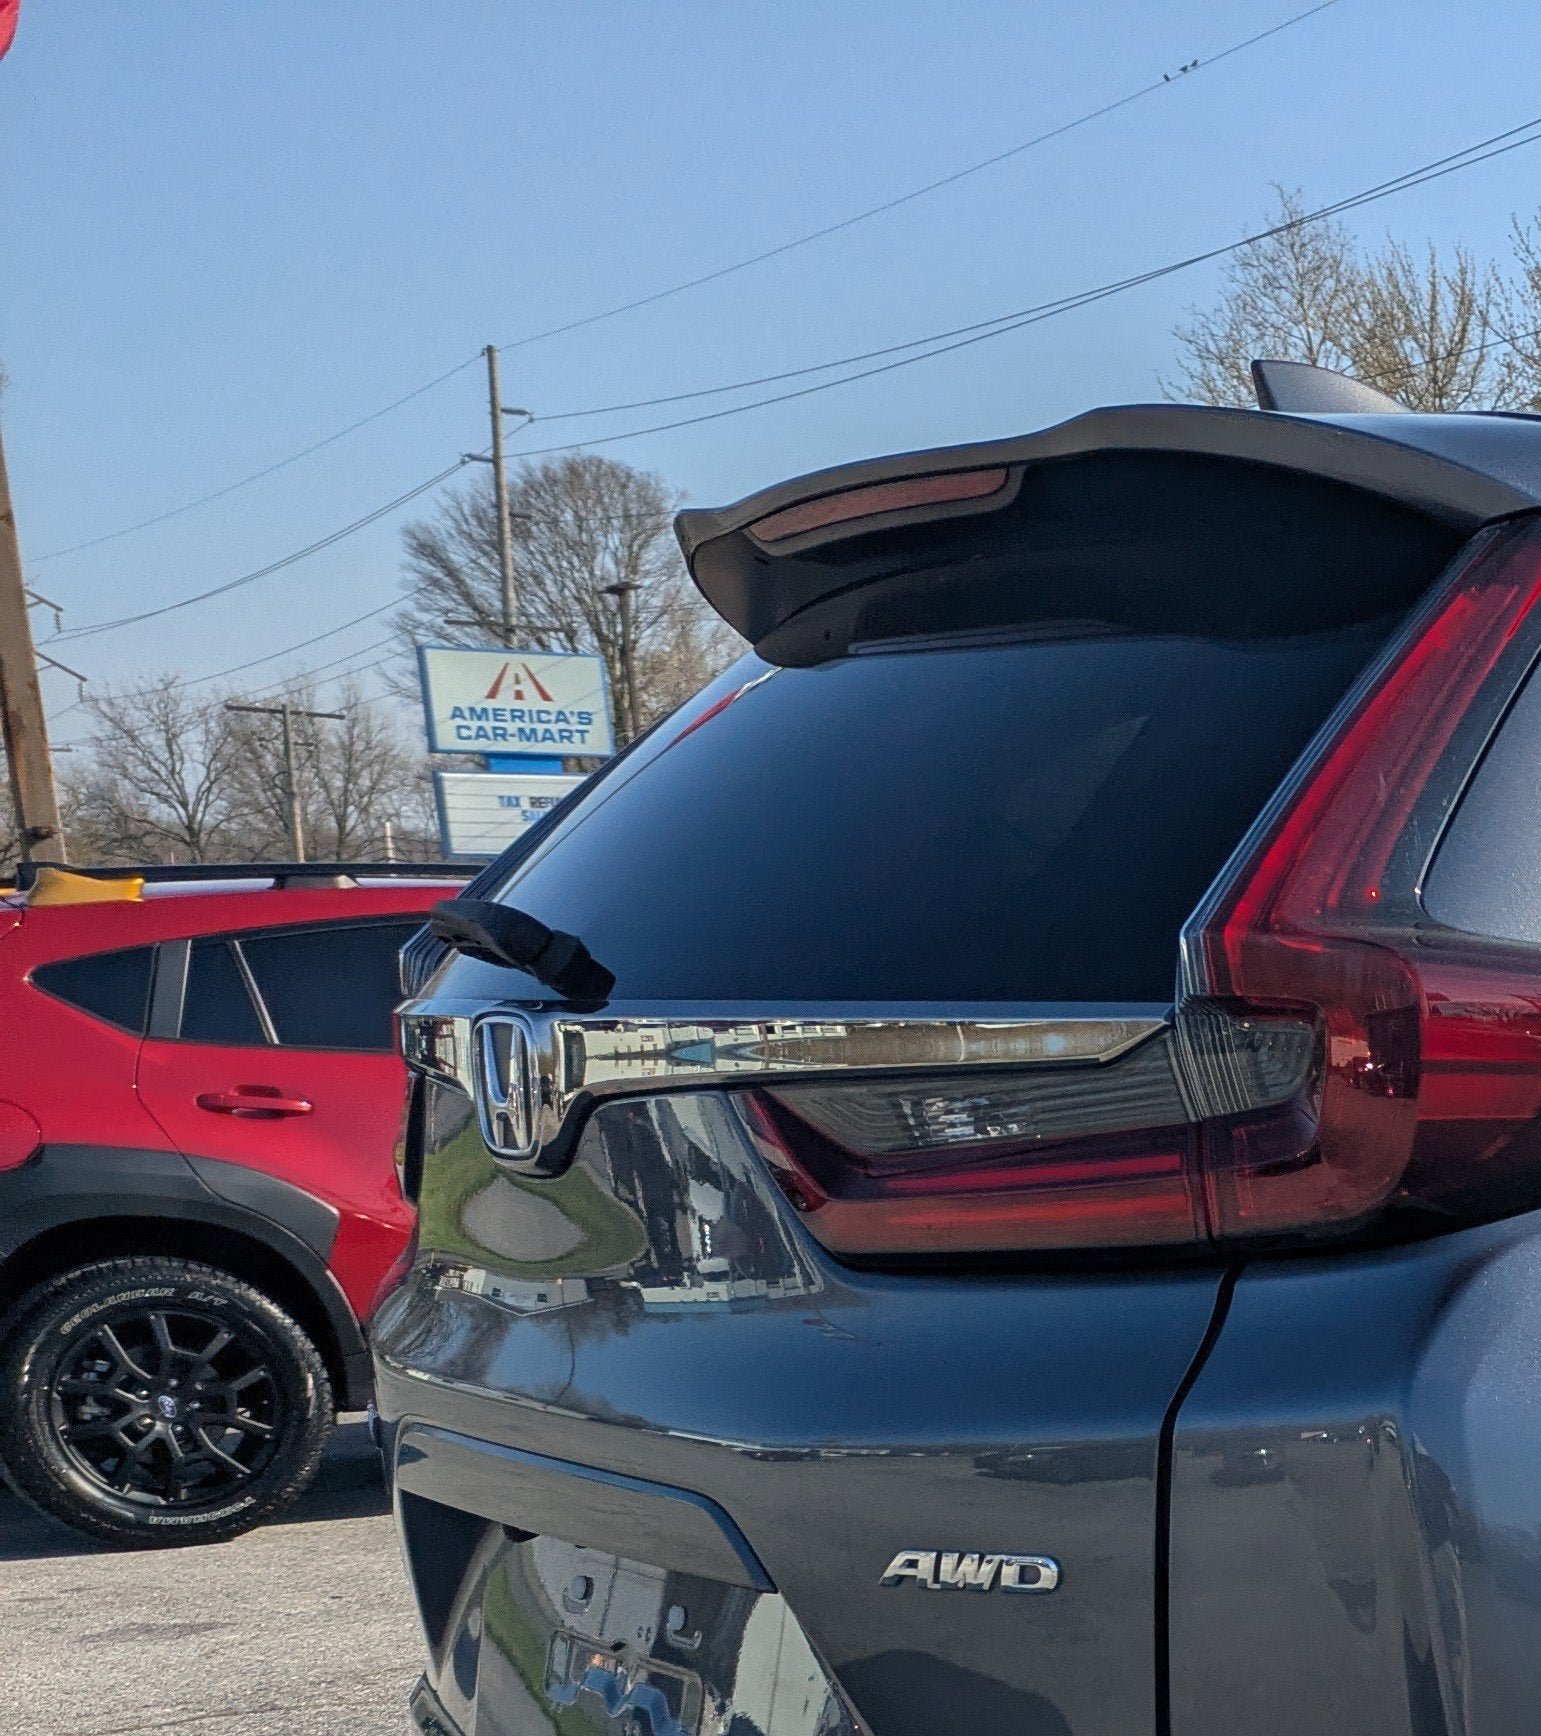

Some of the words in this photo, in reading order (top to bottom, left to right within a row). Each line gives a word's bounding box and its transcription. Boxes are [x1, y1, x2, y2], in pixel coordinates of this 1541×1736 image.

[449, 705, 594, 727] AMERICA'S
[455, 724, 590, 745] CAR-MART
[878, 1549, 1061, 1593] AWD
